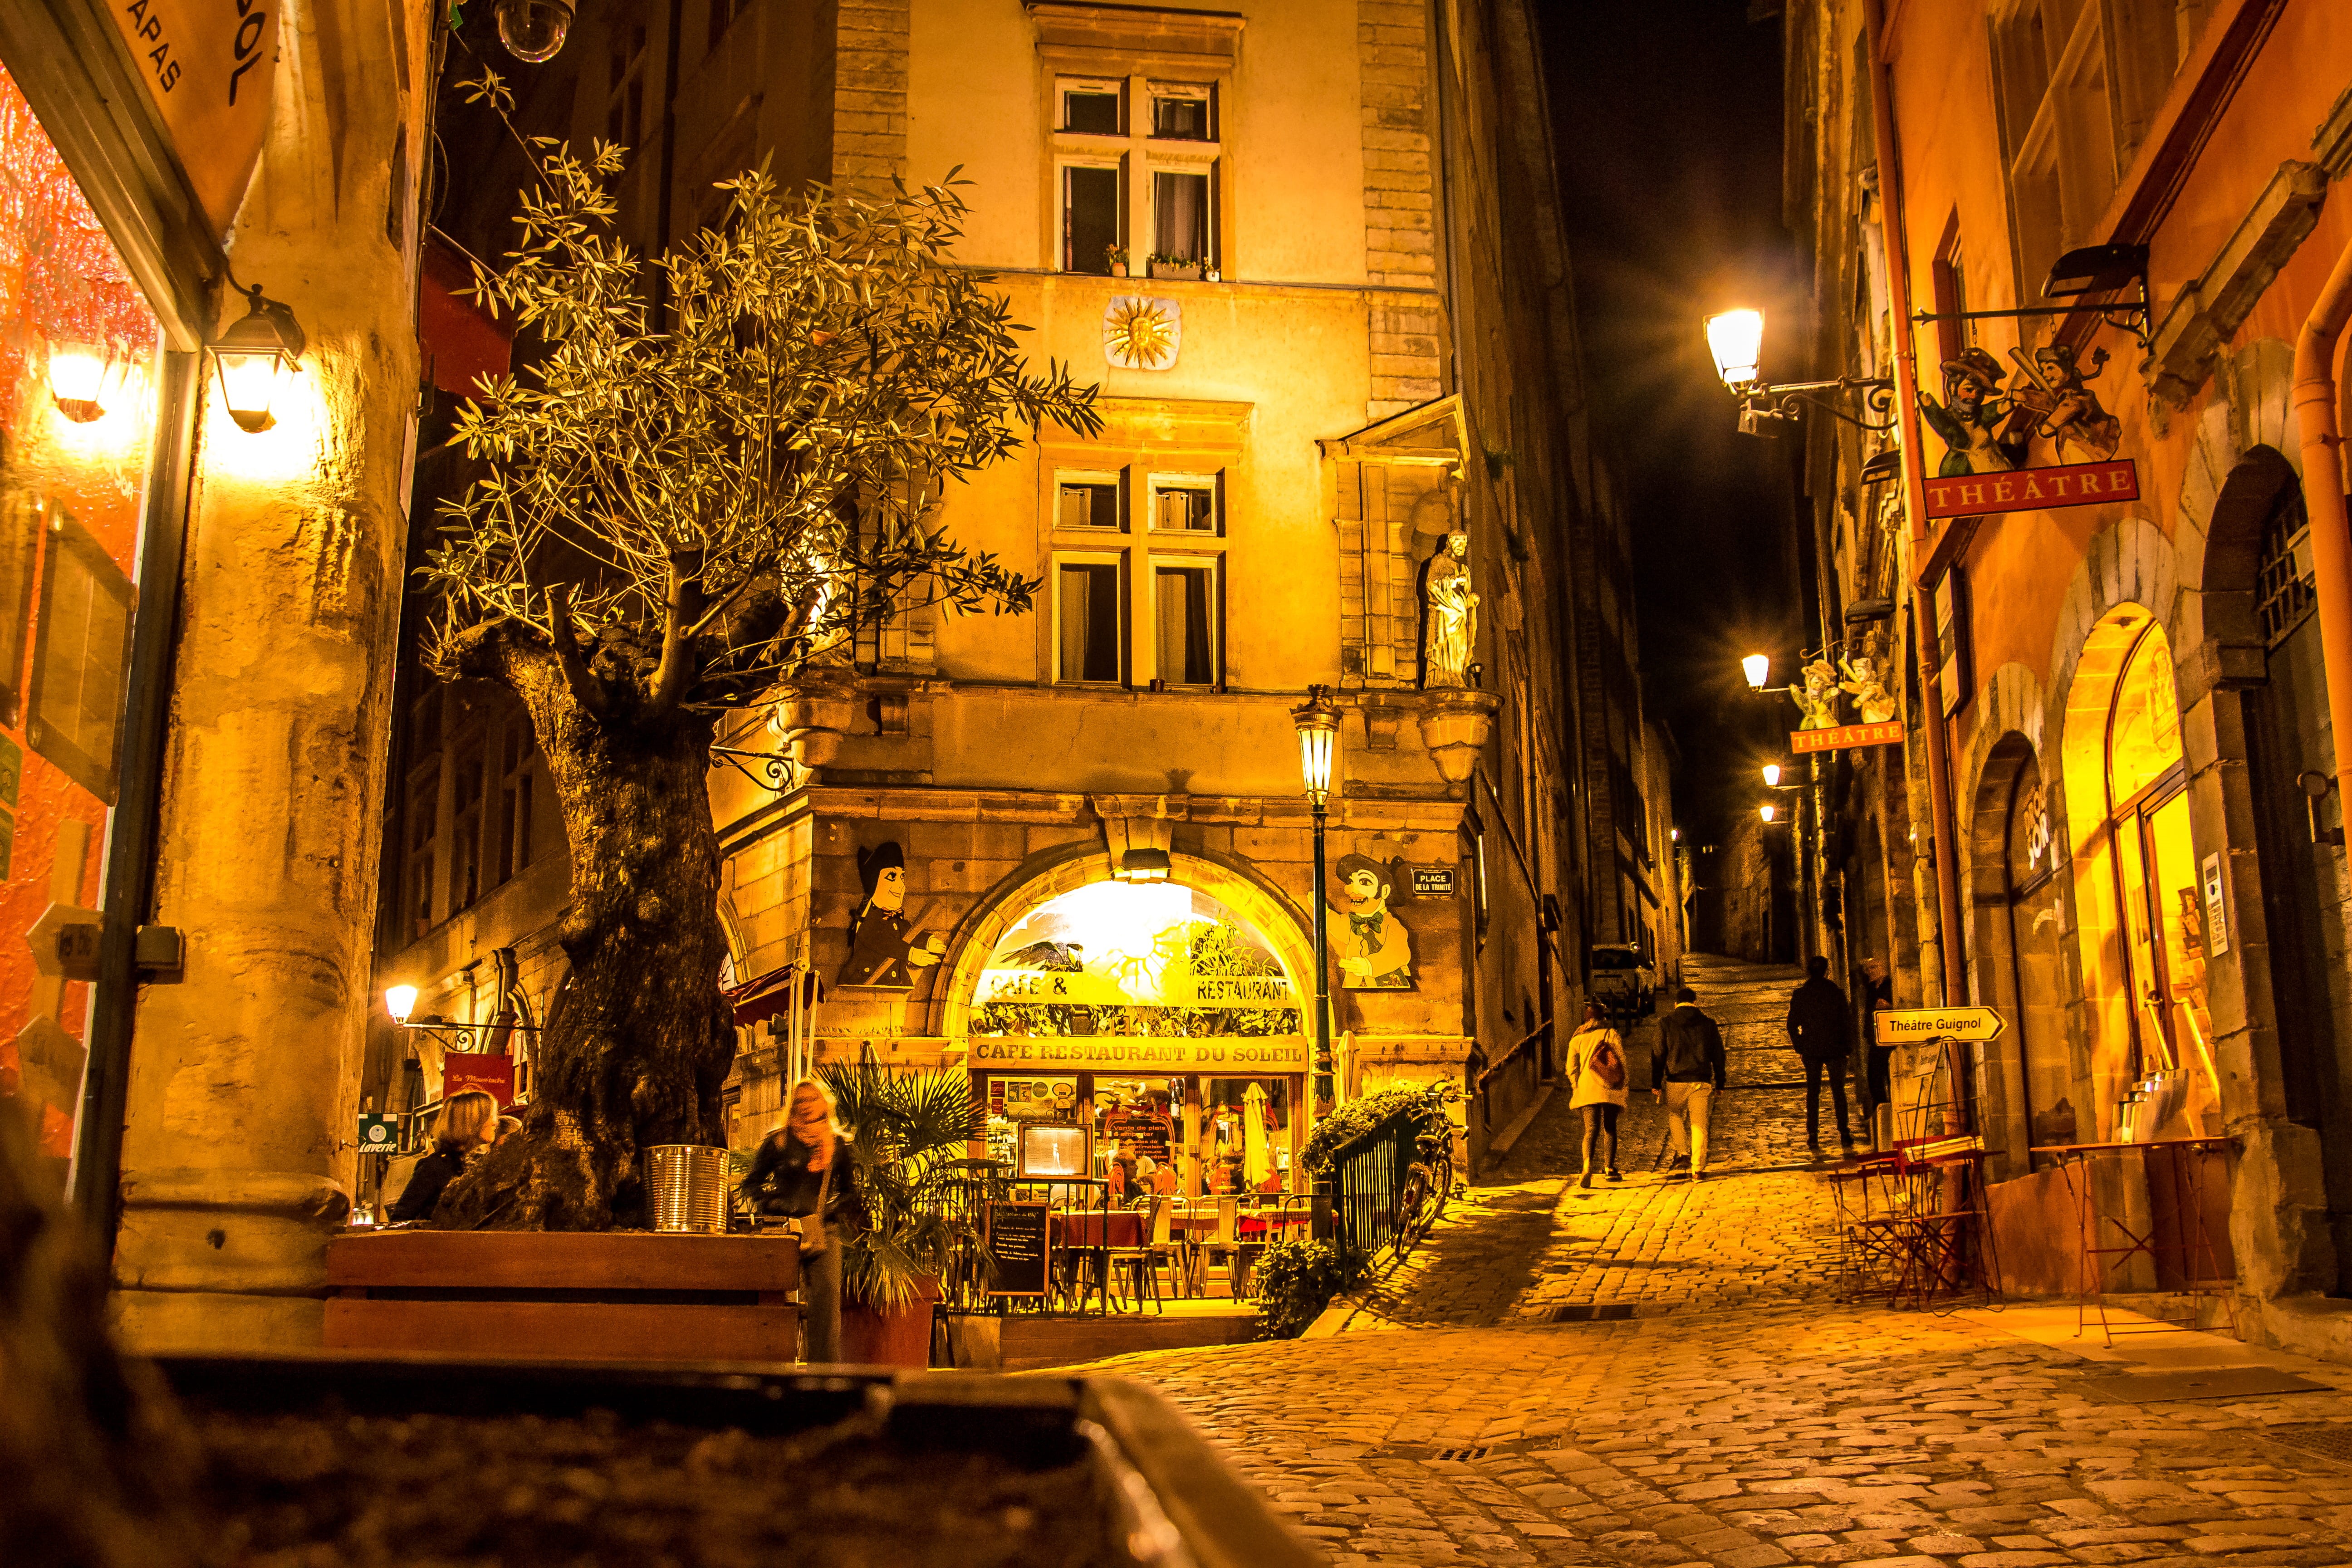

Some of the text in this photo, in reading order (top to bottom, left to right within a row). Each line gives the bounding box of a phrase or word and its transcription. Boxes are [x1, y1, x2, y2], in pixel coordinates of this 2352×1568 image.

[1929, 470, 2131, 508] THÉÂTRE
[1794, 726, 1900, 748] THÉÂTRE
[1053, 977, 1068, 995] &
[1198, 980, 1287, 1000] RESTAURANT
[1889, 1018, 1981, 1032] Théâtre Guignol
[1040, 1045, 1186, 1061] RESTAURANT
[1196, 1047, 1225, 1062] DU
[1233, 1048, 1301, 1062] SOLEIL
